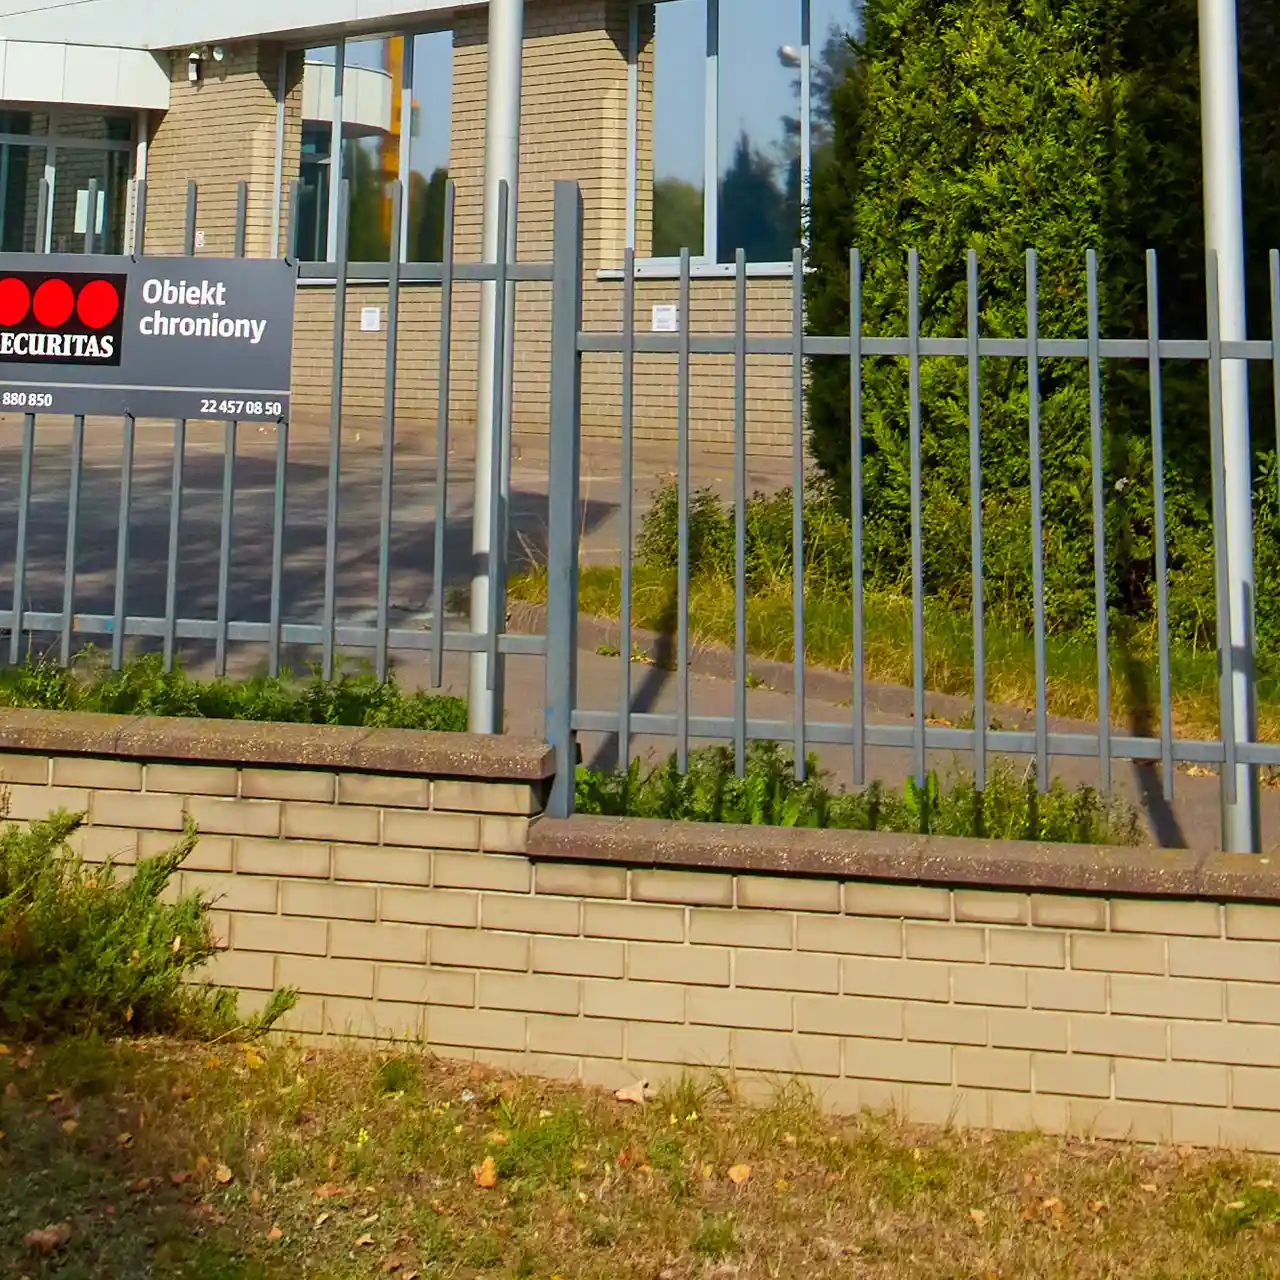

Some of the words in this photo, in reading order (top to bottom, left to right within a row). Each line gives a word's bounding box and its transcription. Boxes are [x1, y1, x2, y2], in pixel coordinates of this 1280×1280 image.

[142, 278, 227, 306] Obiekt
[139, 309, 267, 344] chroniony
[2, 392, 26, 406] 880
[28, 393, 53, 407] 850
[200, 399, 217, 413] 22
[219, 400, 244, 414] 457
[246, 401, 263, 415] 08
[265, 402, 282, 416] 50
